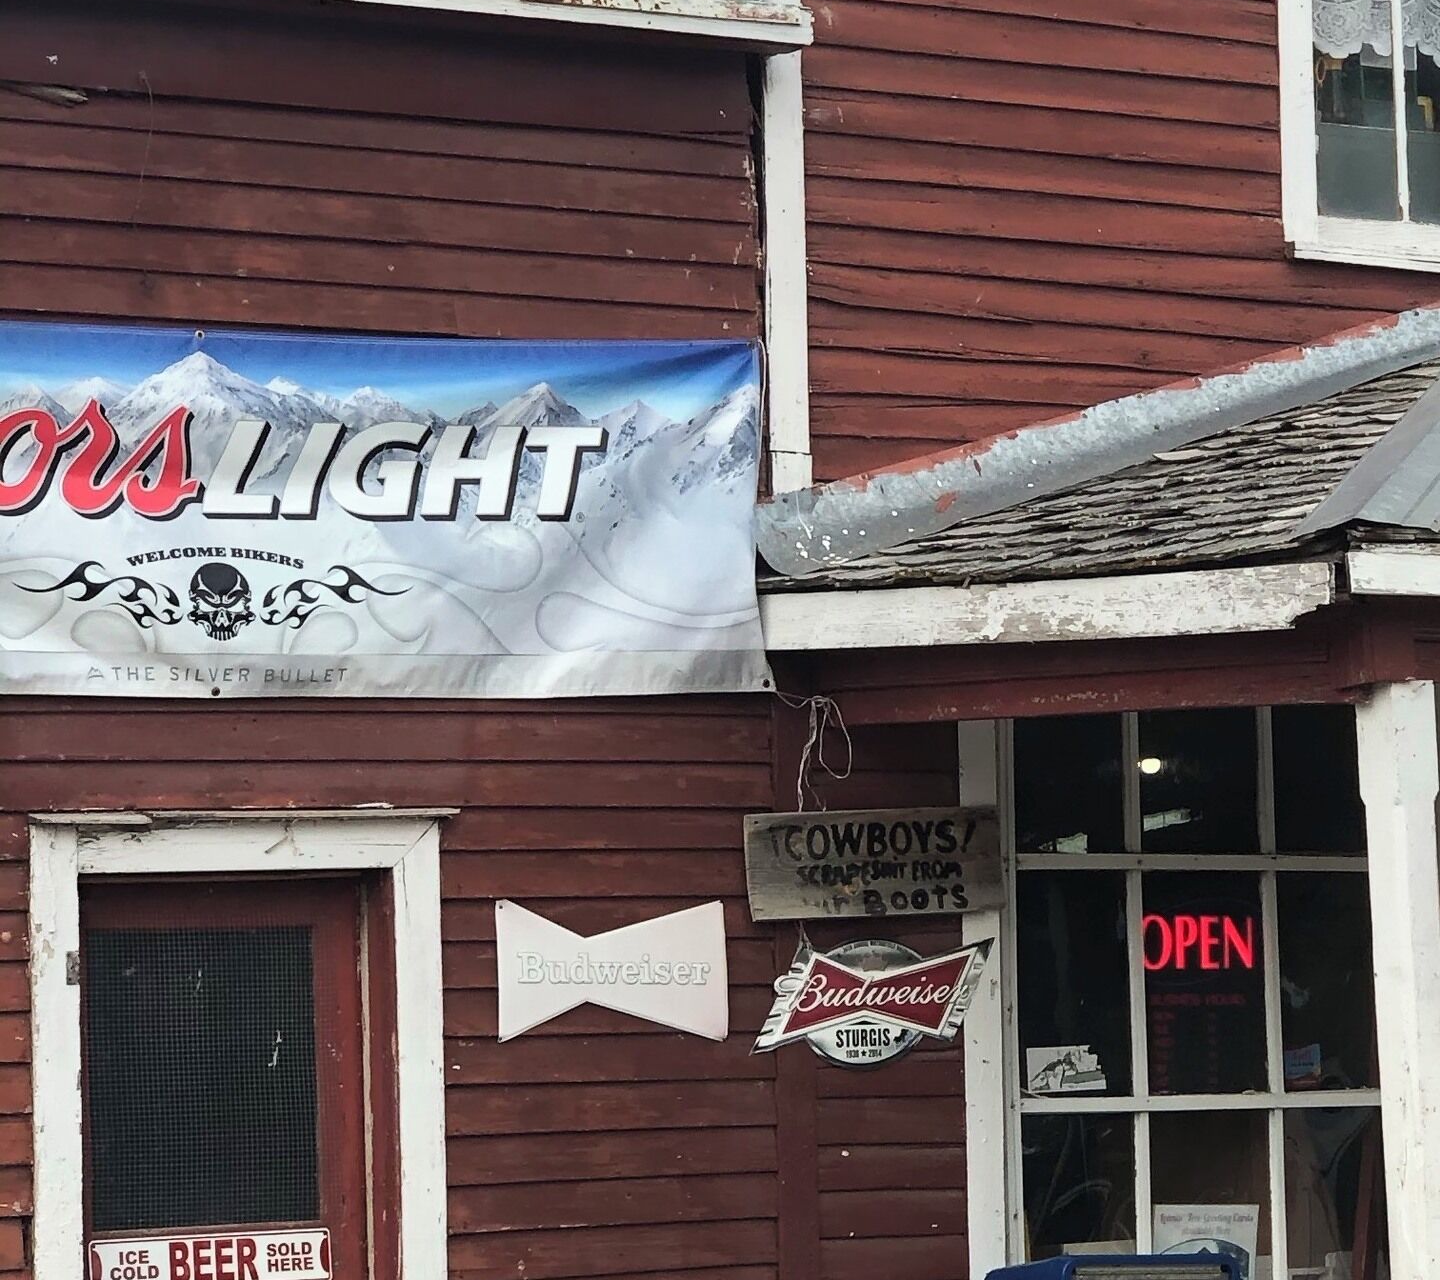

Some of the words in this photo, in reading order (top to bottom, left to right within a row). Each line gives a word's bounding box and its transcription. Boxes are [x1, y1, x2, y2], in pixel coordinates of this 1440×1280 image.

[202, 420, 608, 520] LIGHT
[127, 546, 226, 568] WELCOME
[230, 546, 304, 569] BIKERS
[112, 666, 160, 682] THE
[169, 666, 249, 682] SILVER
[264, 667, 348, 683] BULLET
[911, 859, 963, 882] FROM
[863, 883, 969, 916] BOOTS
[1141, 913, 1255, 971] OPEN
[517, 951, 712, 986] Budweiser
[773, 969, 971, 1013] Budweiser
[836, 1027, 891, 1049] STURGIS
[119, 1250, 150, 1265] ICE
[266, 1242, 313, 1257] SOLD
[110, 1265, 159, 1280] COLD
[267, 1257, 314, 1272] HERE
